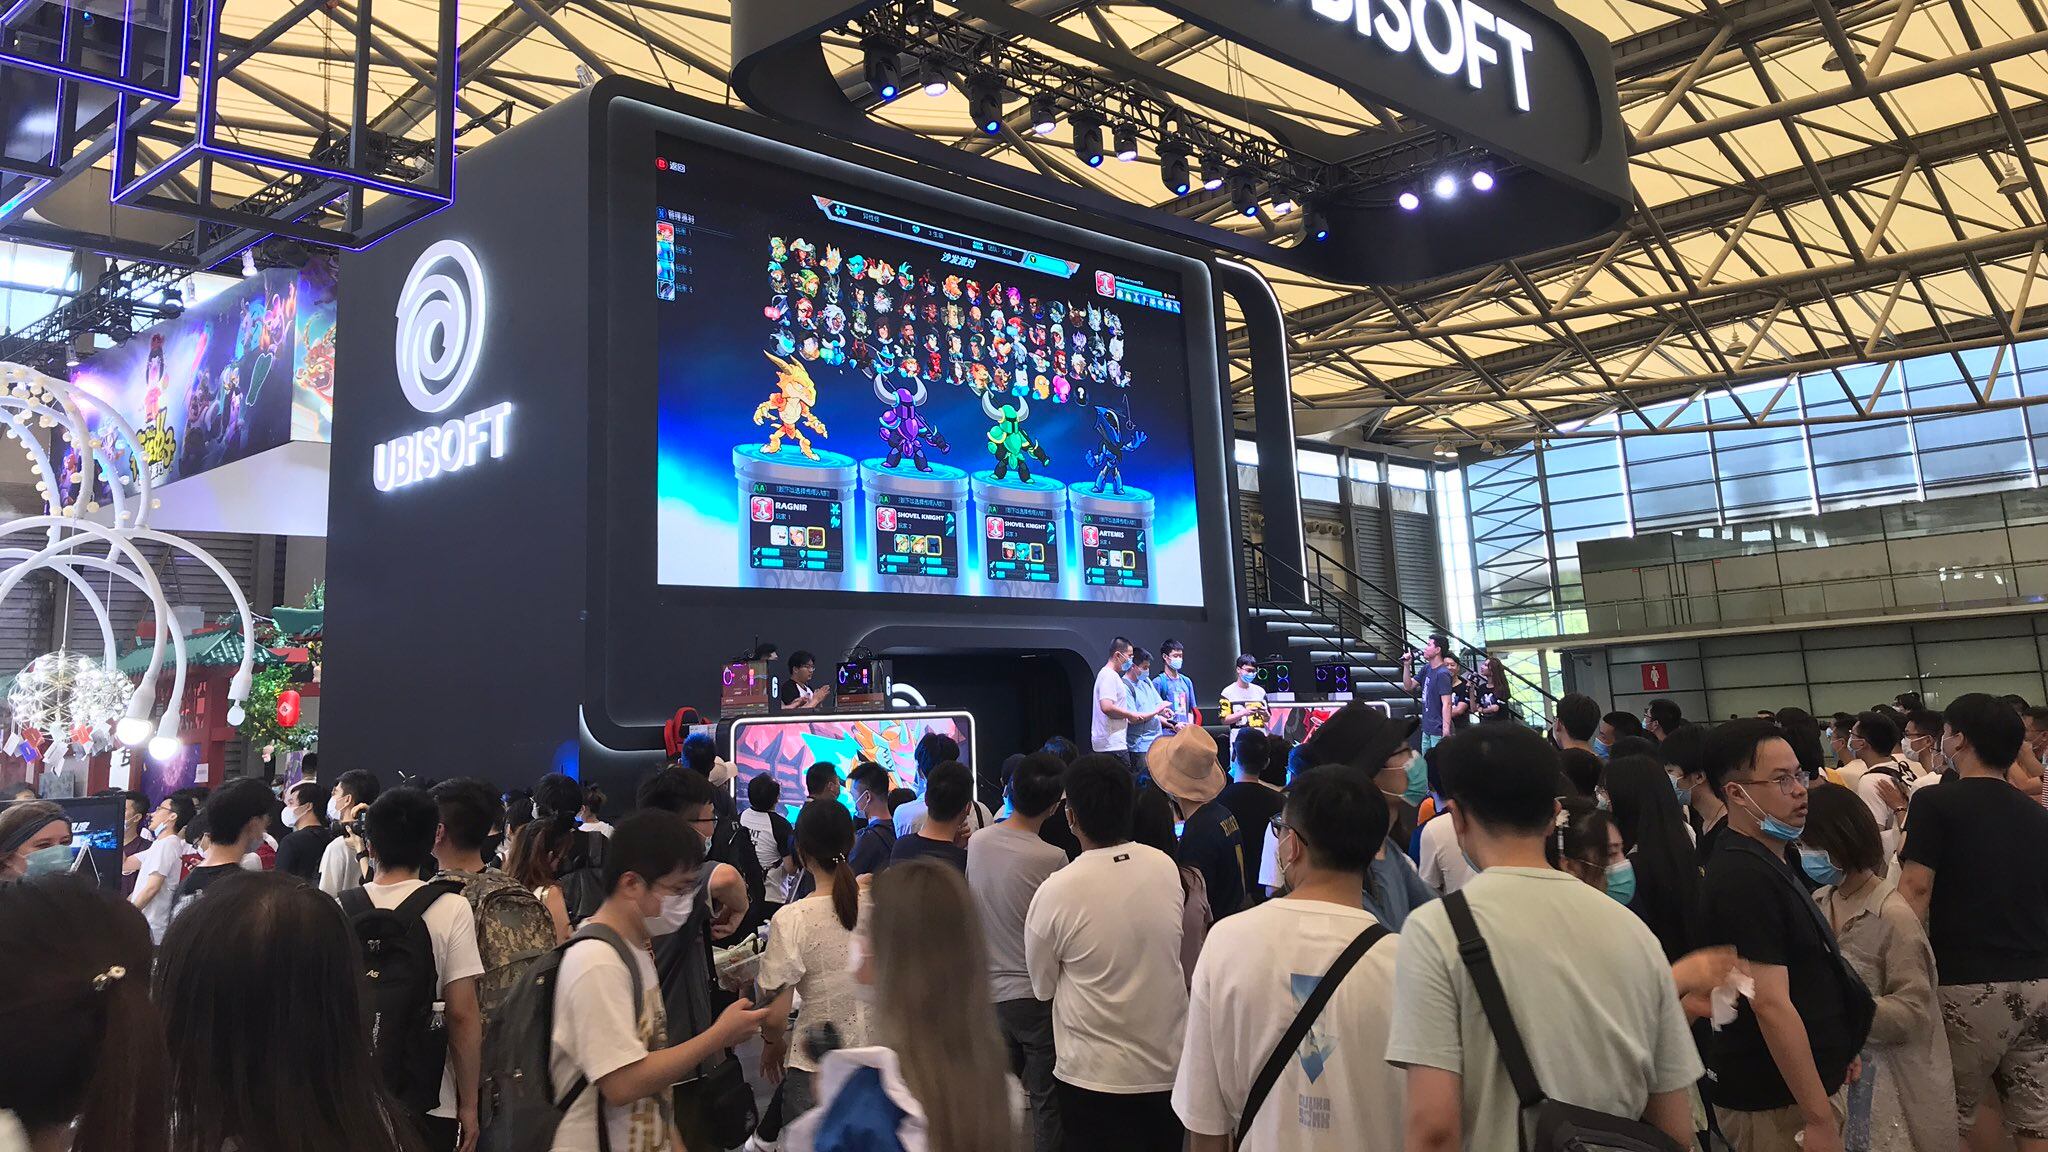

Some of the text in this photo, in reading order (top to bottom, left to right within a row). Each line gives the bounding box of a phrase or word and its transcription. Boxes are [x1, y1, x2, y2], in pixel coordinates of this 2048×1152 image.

[940, 251, 977, 269] 沙发派对
[373, 401, 512, 492] UBISOFT
[775, 501, 808, 512] RAGNIR
[897, 511, 945, 522] SHOVEL KNIGHT
[1004, 520, 1046, 530] SHOVEL KNIGHT
[1099, 529, 1125, 539] ARTEMIS
